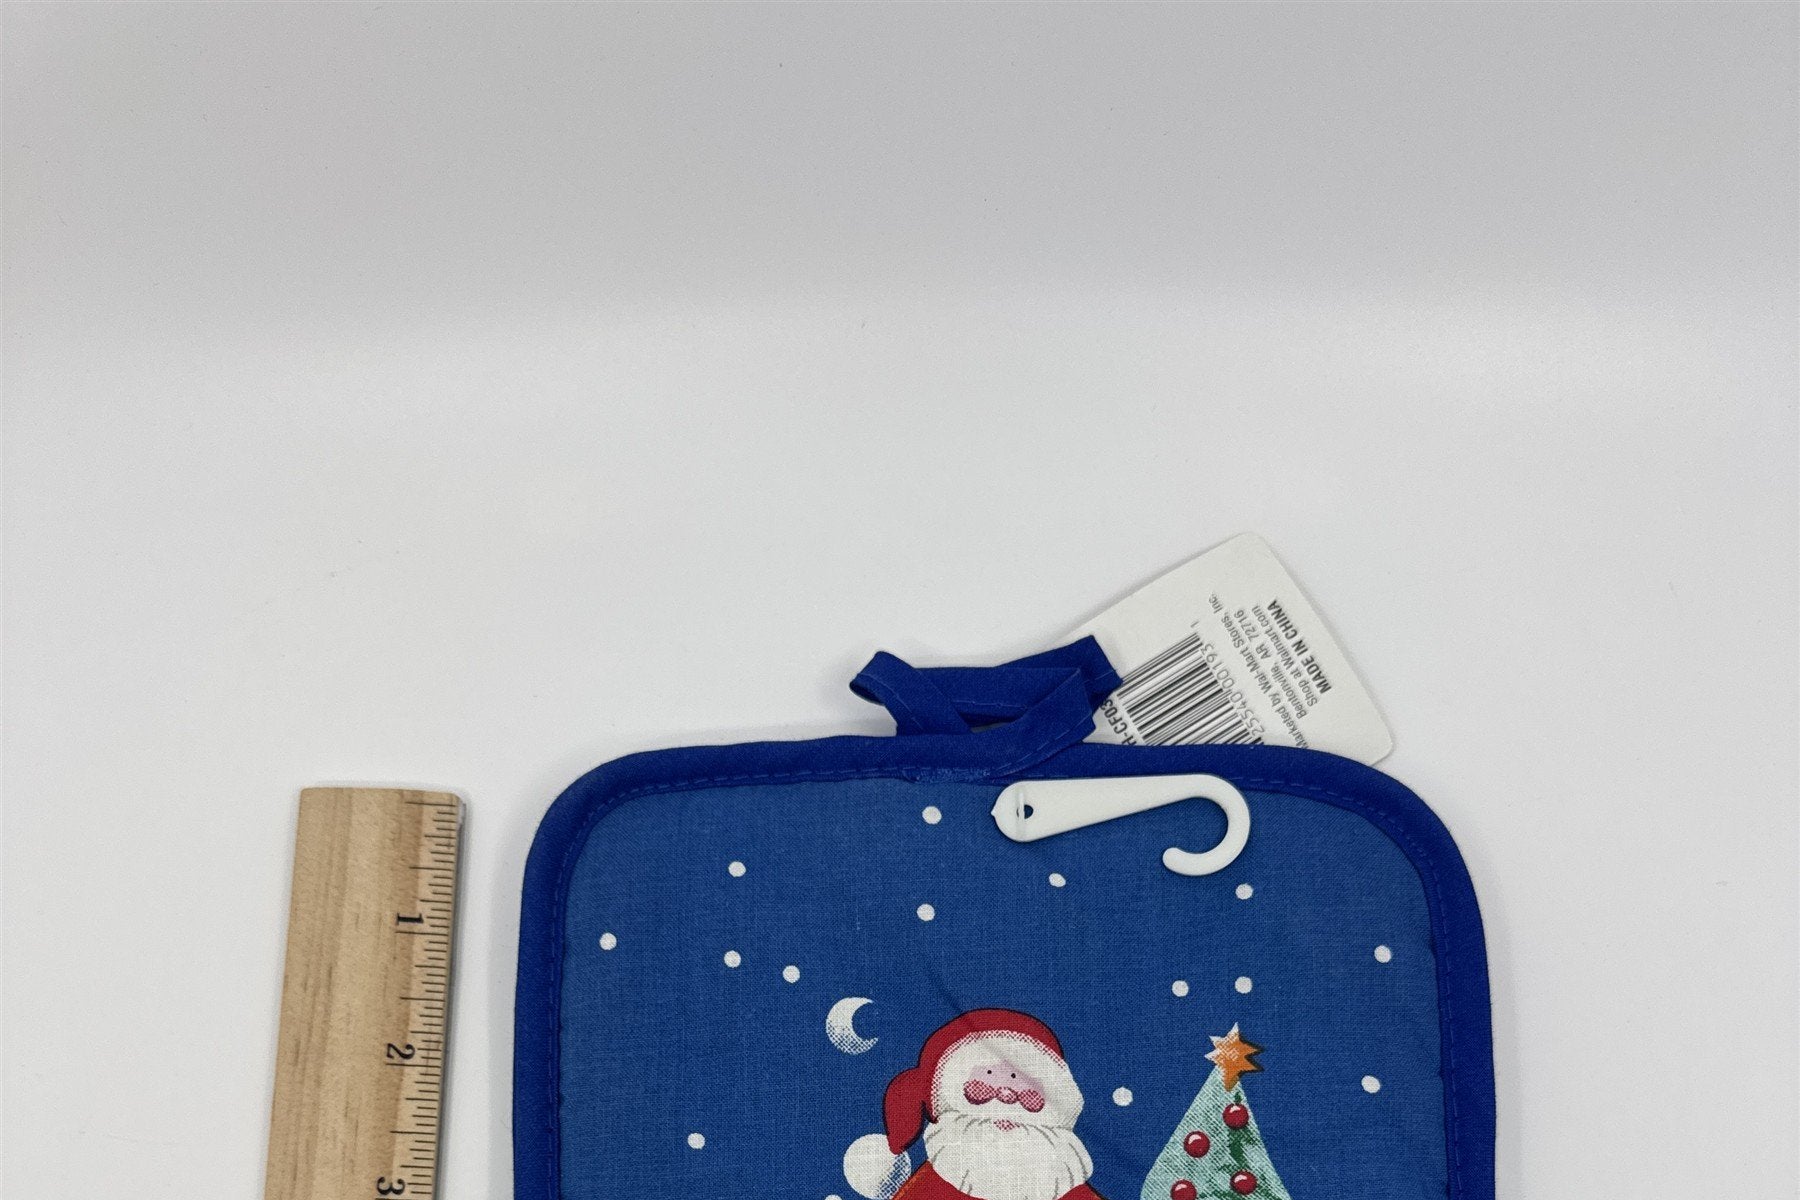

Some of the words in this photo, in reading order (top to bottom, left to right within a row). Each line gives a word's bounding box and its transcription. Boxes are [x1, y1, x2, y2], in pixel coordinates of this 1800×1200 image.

[1220, 612, 1245, 648] Stores,
[1233, 609, 1259, 642] 72716
[1267, 599, 1298, 640] CHINA
[1251, 605, 1295, 670] Walmart.com
[1255, 643, 1271, 660] AR
[1291, 639, 1309, 657] IN
[1200, 643, 1235, 691] 00193
[1240, 646, 1272, 694] Wal-Mart
[1290, 667, 1302, 680] at
[1300, 655, 1332, 694] MADE
[1269, 692, 1282, 708] by
[1298, 679, 1319, 707] Shop
[1230, 690, 1265, 736] 25540
[396, 913, 424, 926] 1
[386, 1043, 416, 1061] 2
[376, 1176, 406, 1196] 3
